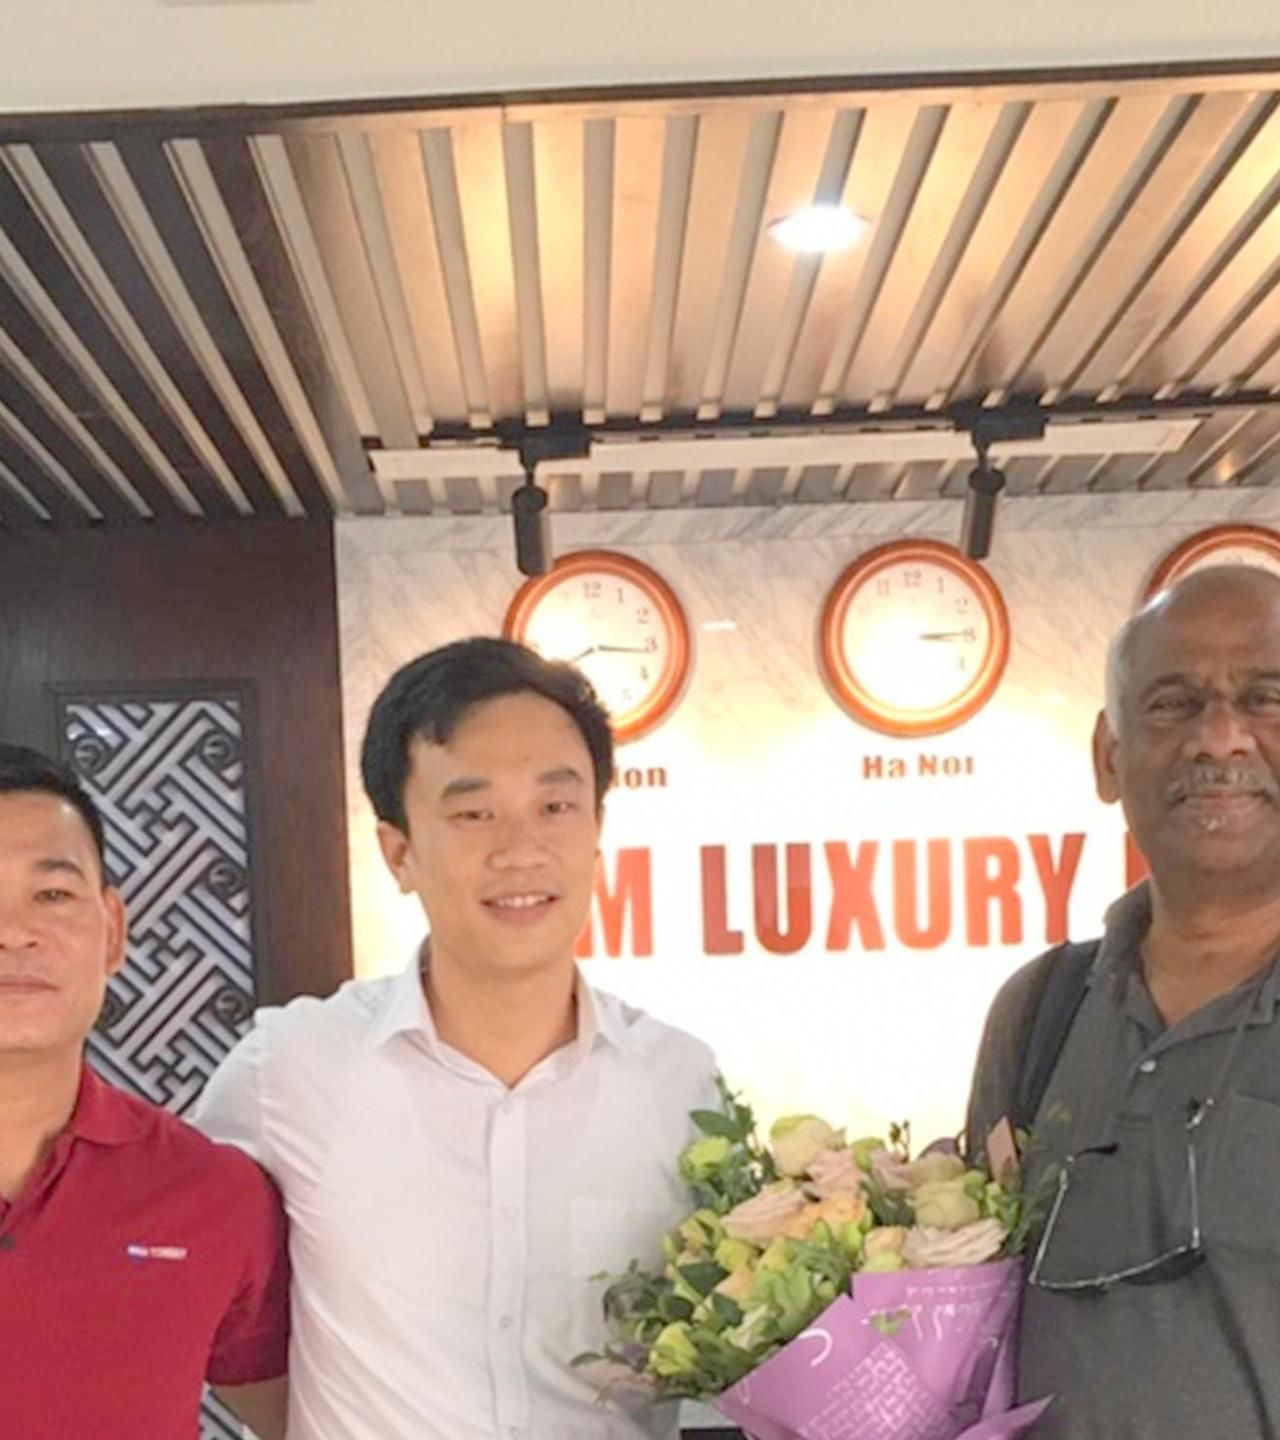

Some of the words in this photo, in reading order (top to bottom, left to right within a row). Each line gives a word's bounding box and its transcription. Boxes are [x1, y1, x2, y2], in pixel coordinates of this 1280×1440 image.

[903, 570, 922, 588] 12
[583, 581, 601, 598] 12
[616, 587, 624, 604] 1
[637, 606, 649, 624] 2
[862, 754, 907, 779] Ha
[918, 753, 974, 777] Noi
[700, 832, 1087, 957] LUXURY
